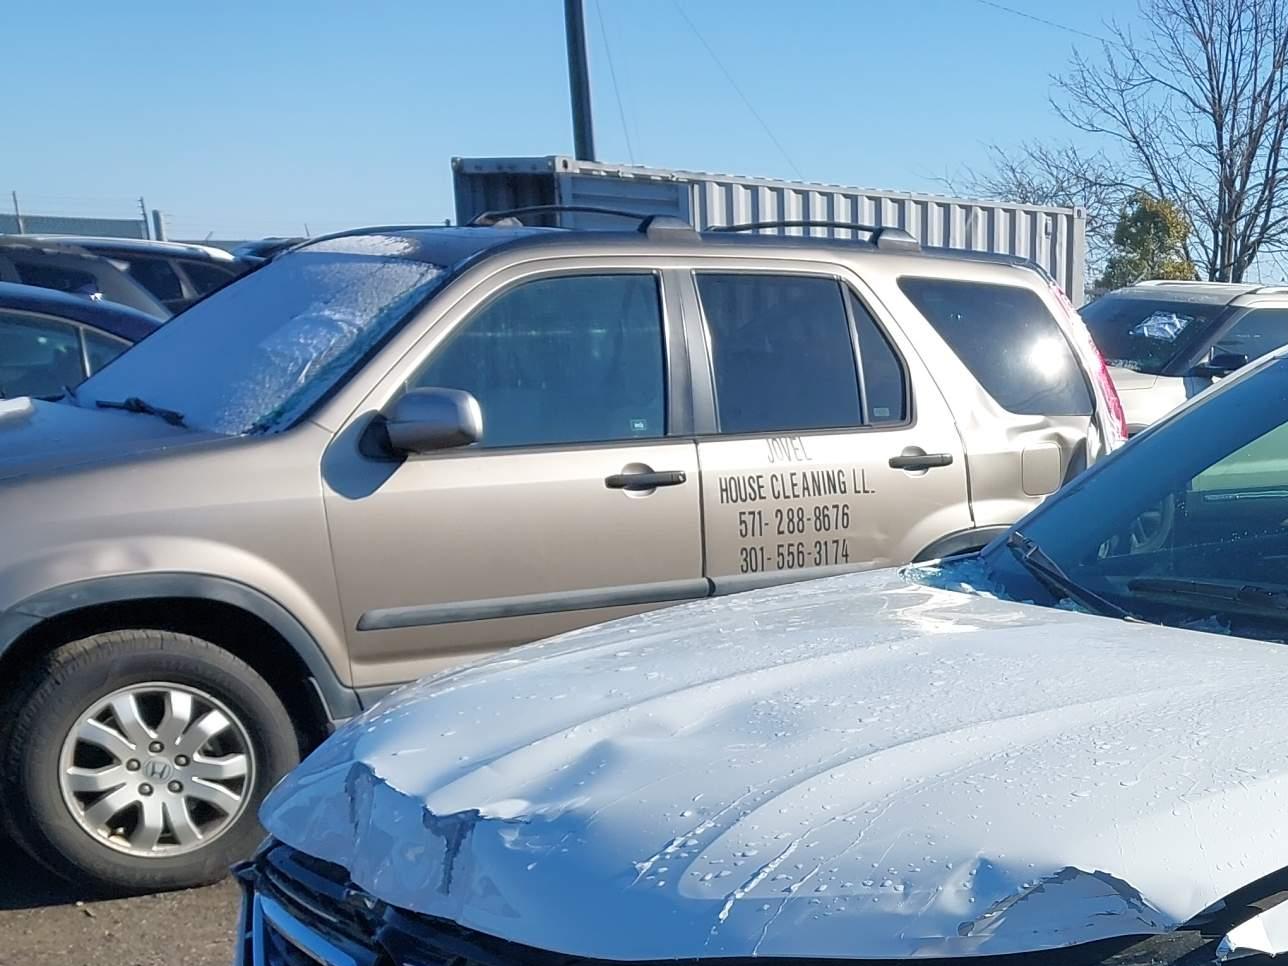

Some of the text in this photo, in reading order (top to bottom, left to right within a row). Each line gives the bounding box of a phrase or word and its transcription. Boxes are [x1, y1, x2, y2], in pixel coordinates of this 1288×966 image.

[766, 436, 812, 464] JOVEL
[719, 475, 766, 504] HOUSE
[770, 470, 847, 500] CLEANING
